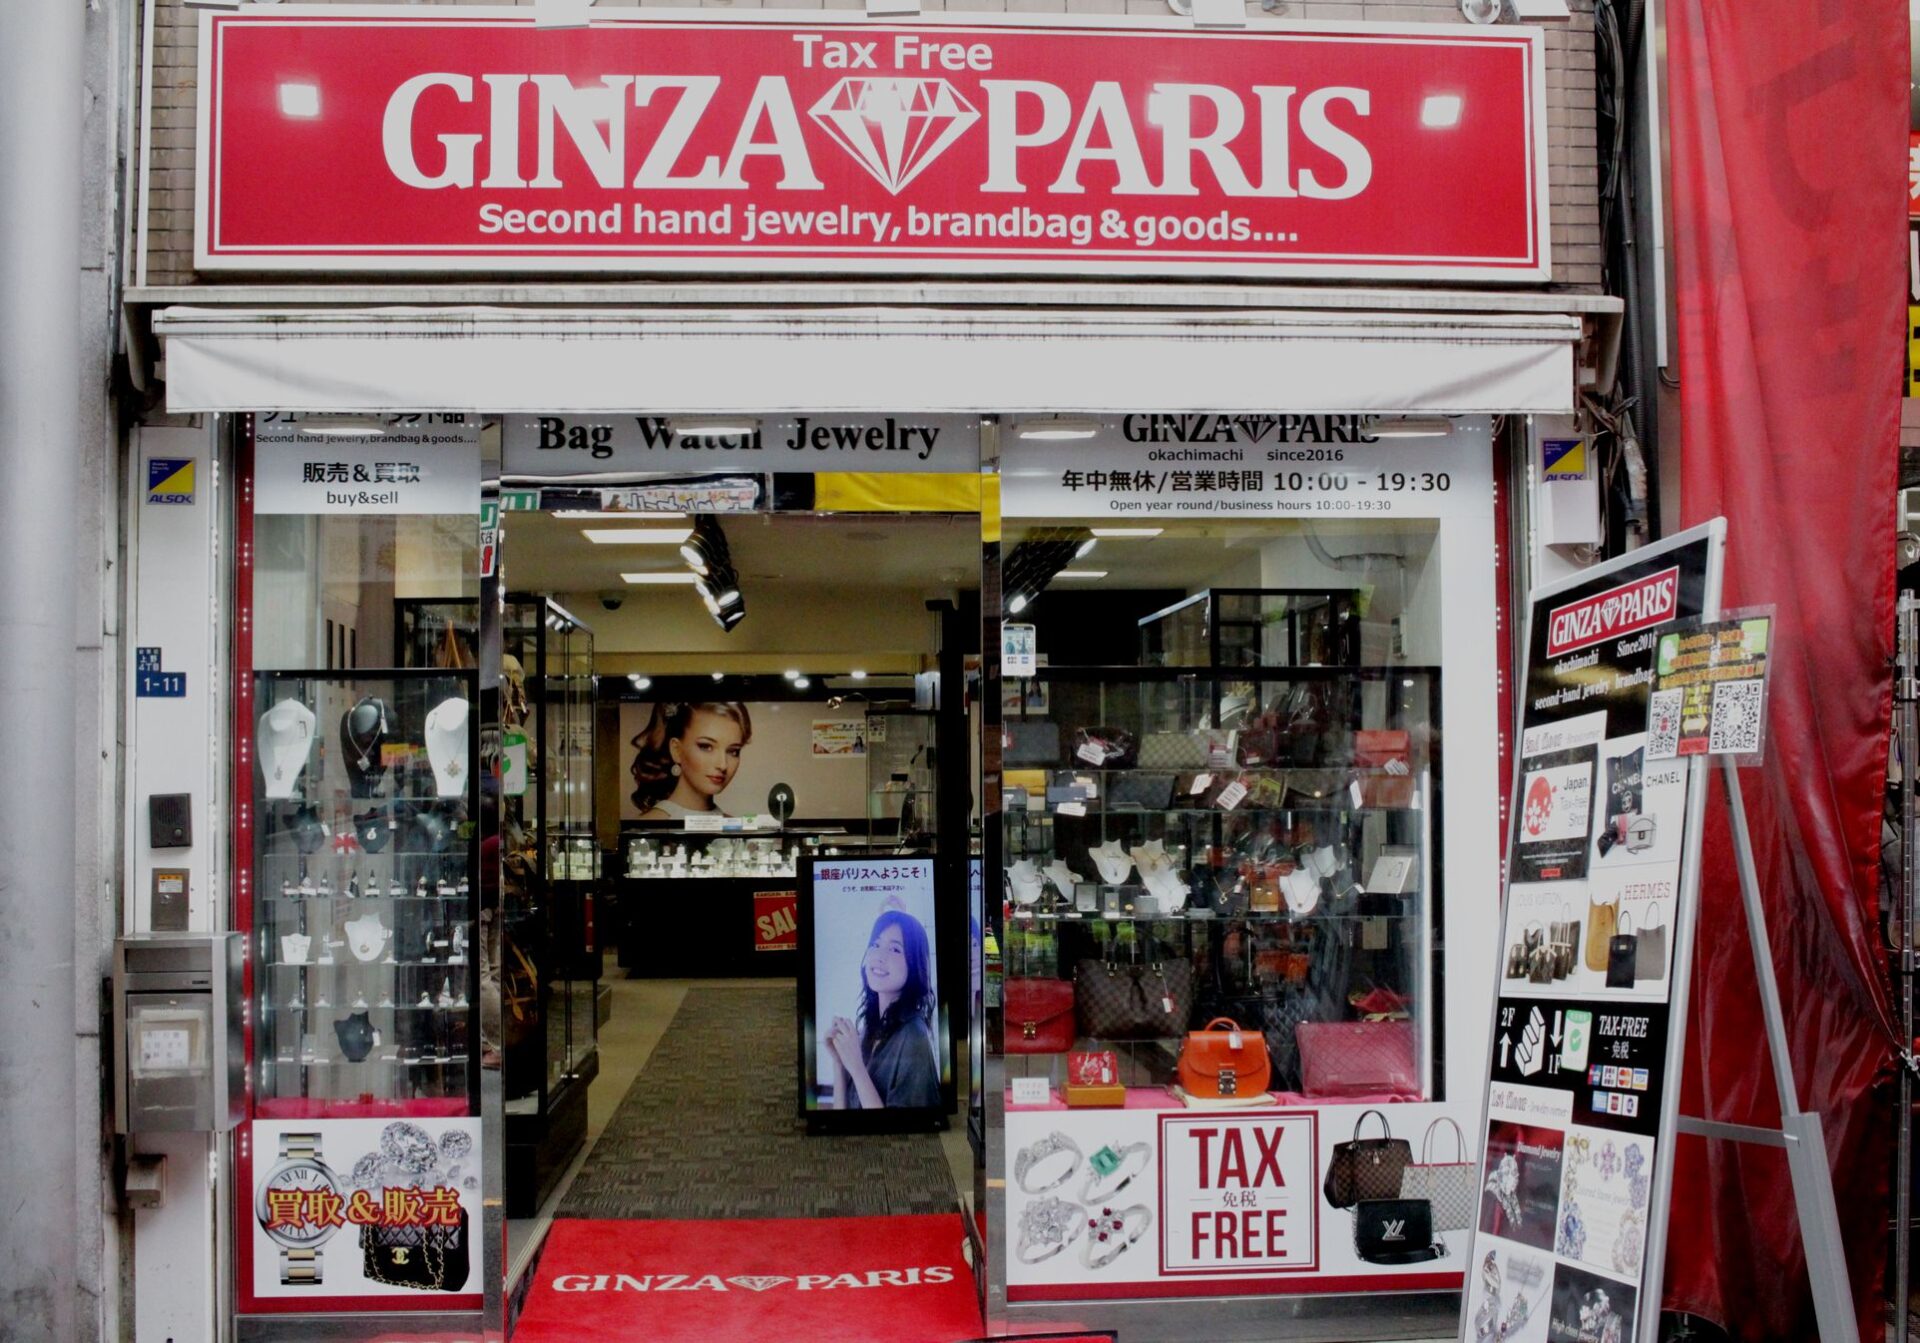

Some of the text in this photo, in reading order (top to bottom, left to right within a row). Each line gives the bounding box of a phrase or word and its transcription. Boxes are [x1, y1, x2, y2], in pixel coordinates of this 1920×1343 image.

[793, 34, 993, 71] Tax Free
[381, 72, 1373, 200] GINZA PARIS
[478, 203, 622, 235] Second
[633, 203, 732, 235] hand
[256, 434, 294, 443] Second
[297, 434, 323, 443] hand
[537, 417, 613, 459] Bag
[786, 417, 941, 460] Jewelry
[1122, 414, 1237, 443] GINZA
[1149, 448, 1344, 462] okachimachi since2016
[1062, 470, 1263, 493] 年中無休/営業時間
[1273, 472, 1348, 491] 10:00
[1376, 472, 1451, 491] 19:30
[149, 494, 193, 504] ALSOK
[326, 490, 399, 507] buy&sell
[1109, 499, 1391, 512] Open year round/business hours 10:00-19:30
[1552, 577, 1674, 647] GINZA PARIS
[144, 677, 179, 692] 1-11
[1646, 771, 1681, 788] CHANEL
[1501, 1007, 1516, 1028] 2F
[1599, 1015, 1650, 1038] TAX-FREE
[1611, 1040, 1630, 1060] 免税
[1188, 1126, 1286, 1190] TAX
[266, 1186, 461, 1228] 買取&販売
[1222, 1190, 1258, 1209] 免税
[1191, 1209, 1287, 1260] FREE
[552, 1266, 955, 1292] GINZA PARIS
